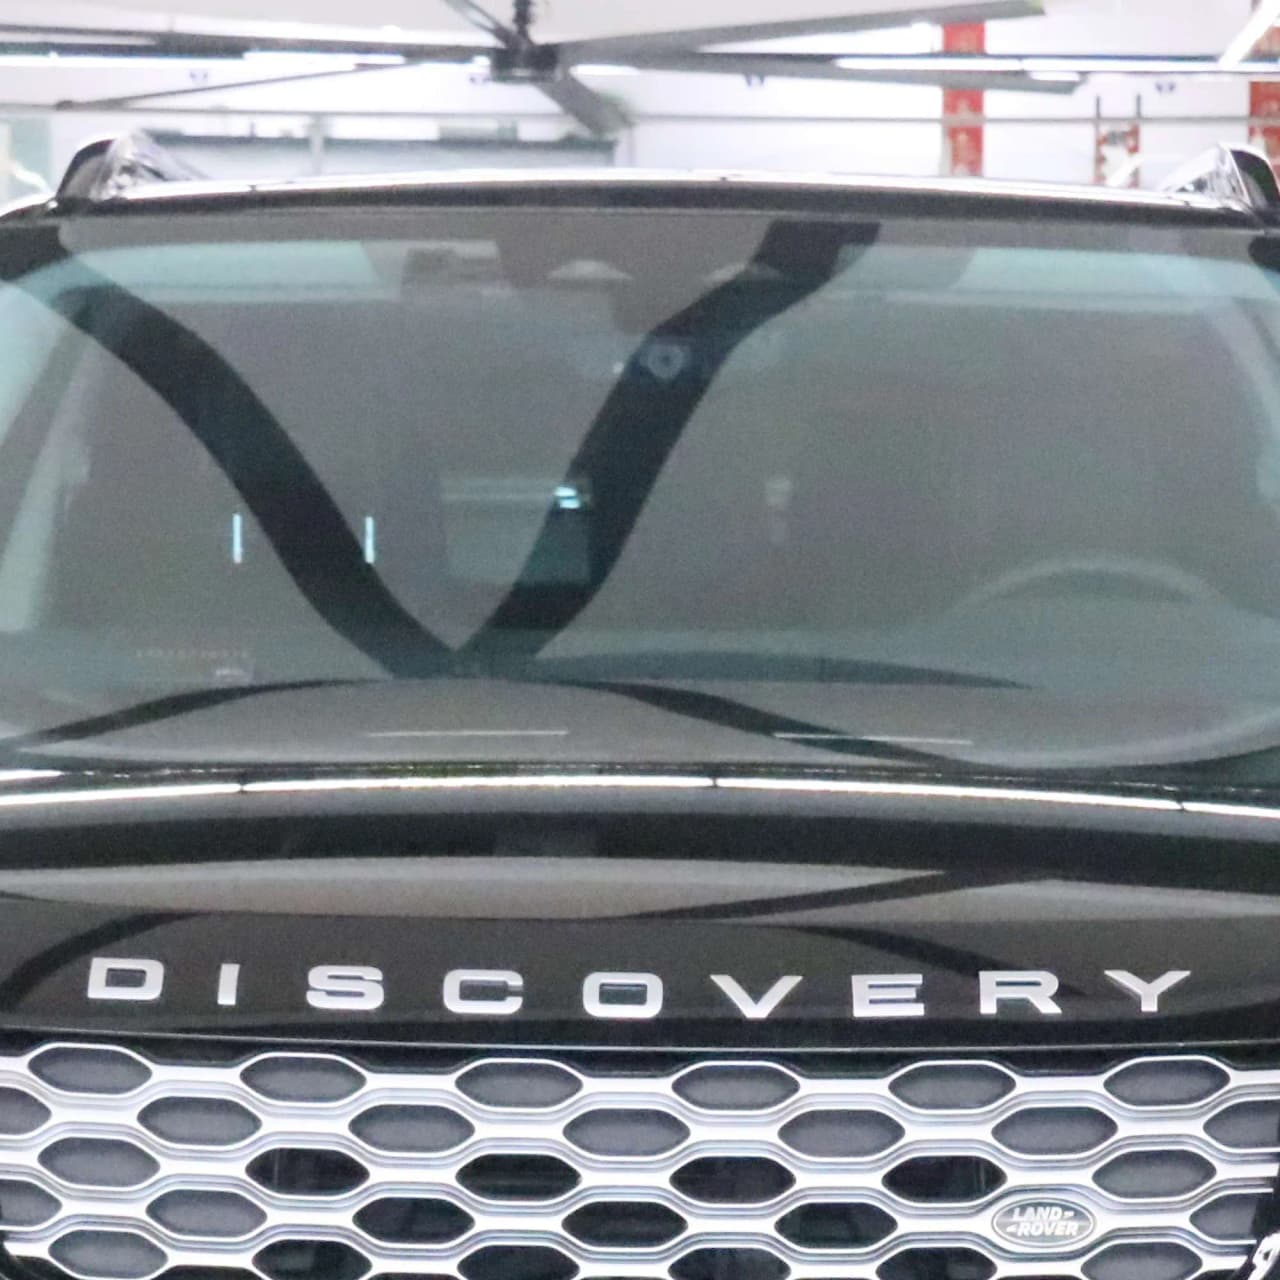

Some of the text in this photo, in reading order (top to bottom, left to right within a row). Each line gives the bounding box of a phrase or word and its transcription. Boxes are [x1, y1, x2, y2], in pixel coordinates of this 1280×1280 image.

[87, 957, 1191, 1019] DISCOVERY
[1012, 1206, 1062, 1220] LAND
[1018, 1221, 1079, 1236] ROVER
